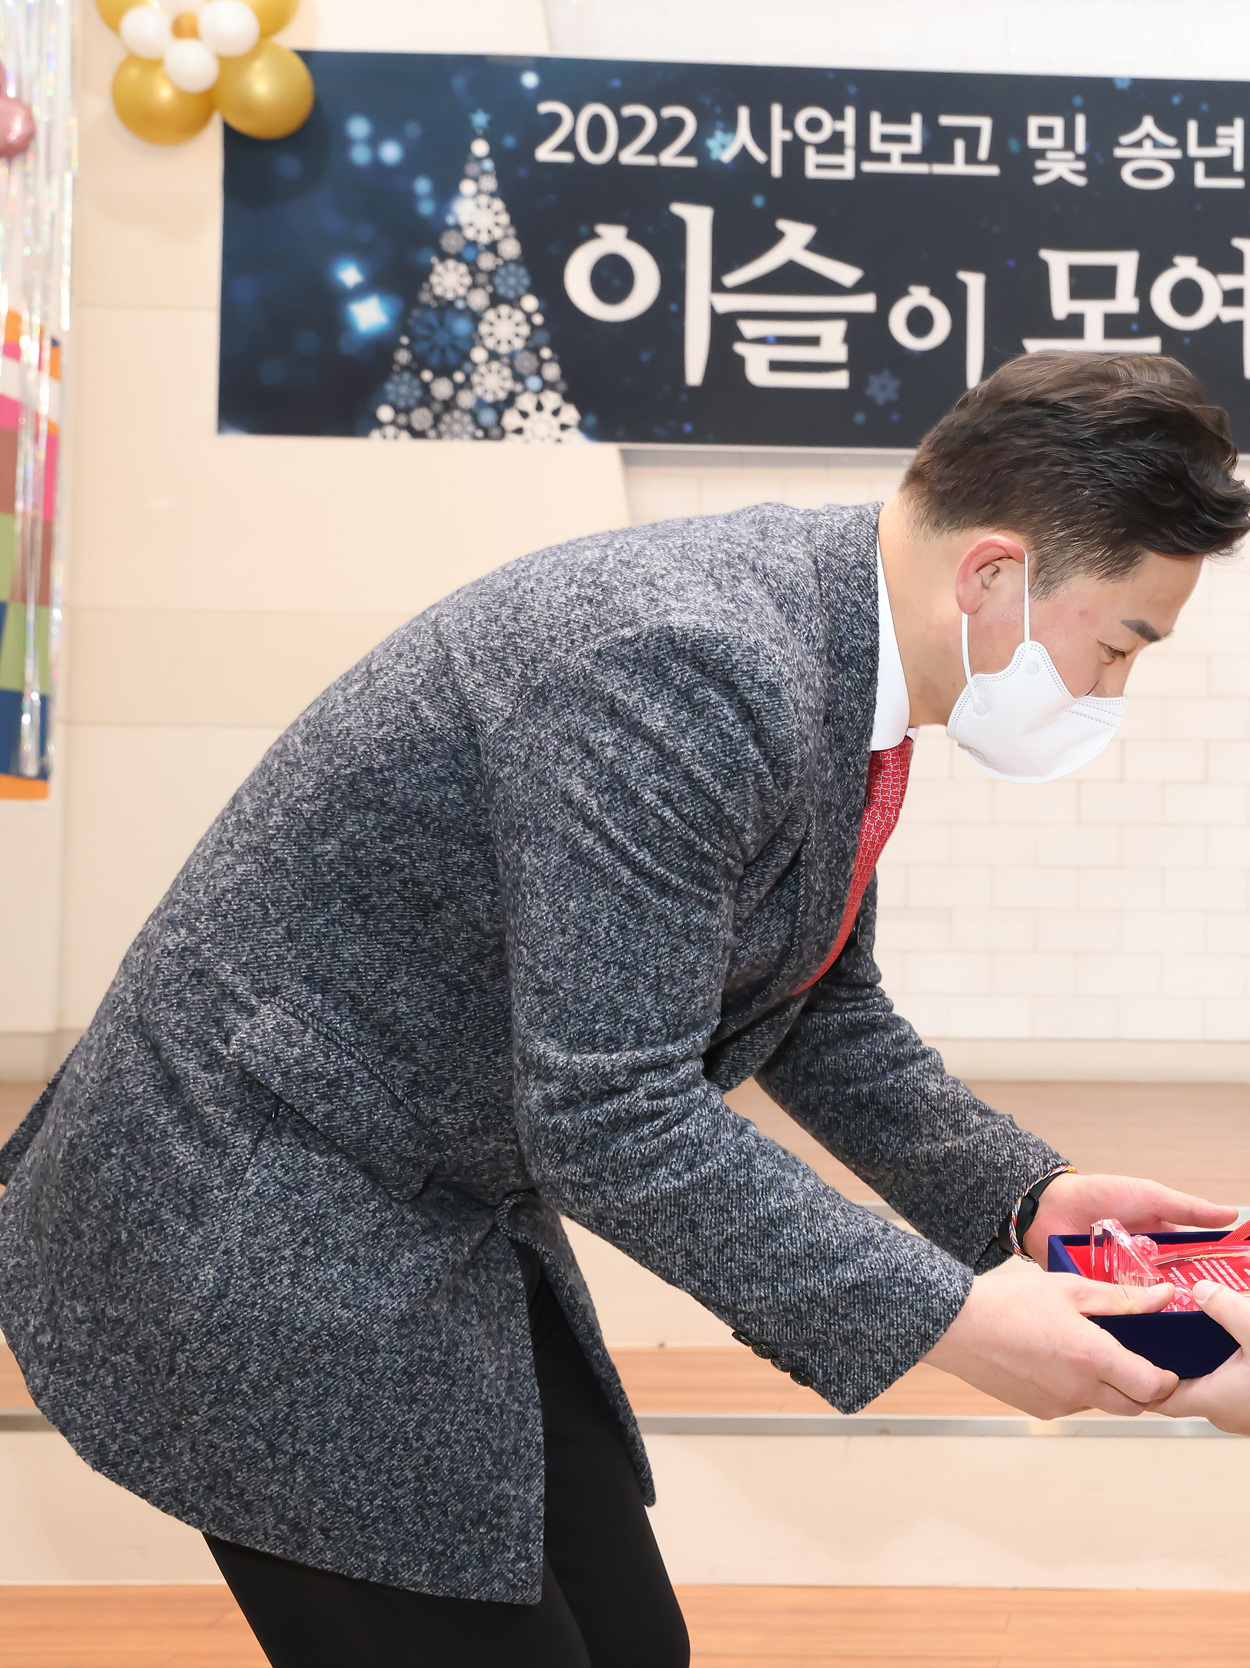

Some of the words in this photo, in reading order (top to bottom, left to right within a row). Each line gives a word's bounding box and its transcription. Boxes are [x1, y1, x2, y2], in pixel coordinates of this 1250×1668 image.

[535, 101, 697, 167] 2022
[719, 103, 1000, 180] 사업보고
[1027, 113, 1087, 187] 및
[564, 203, 986, 389] 이슬이
